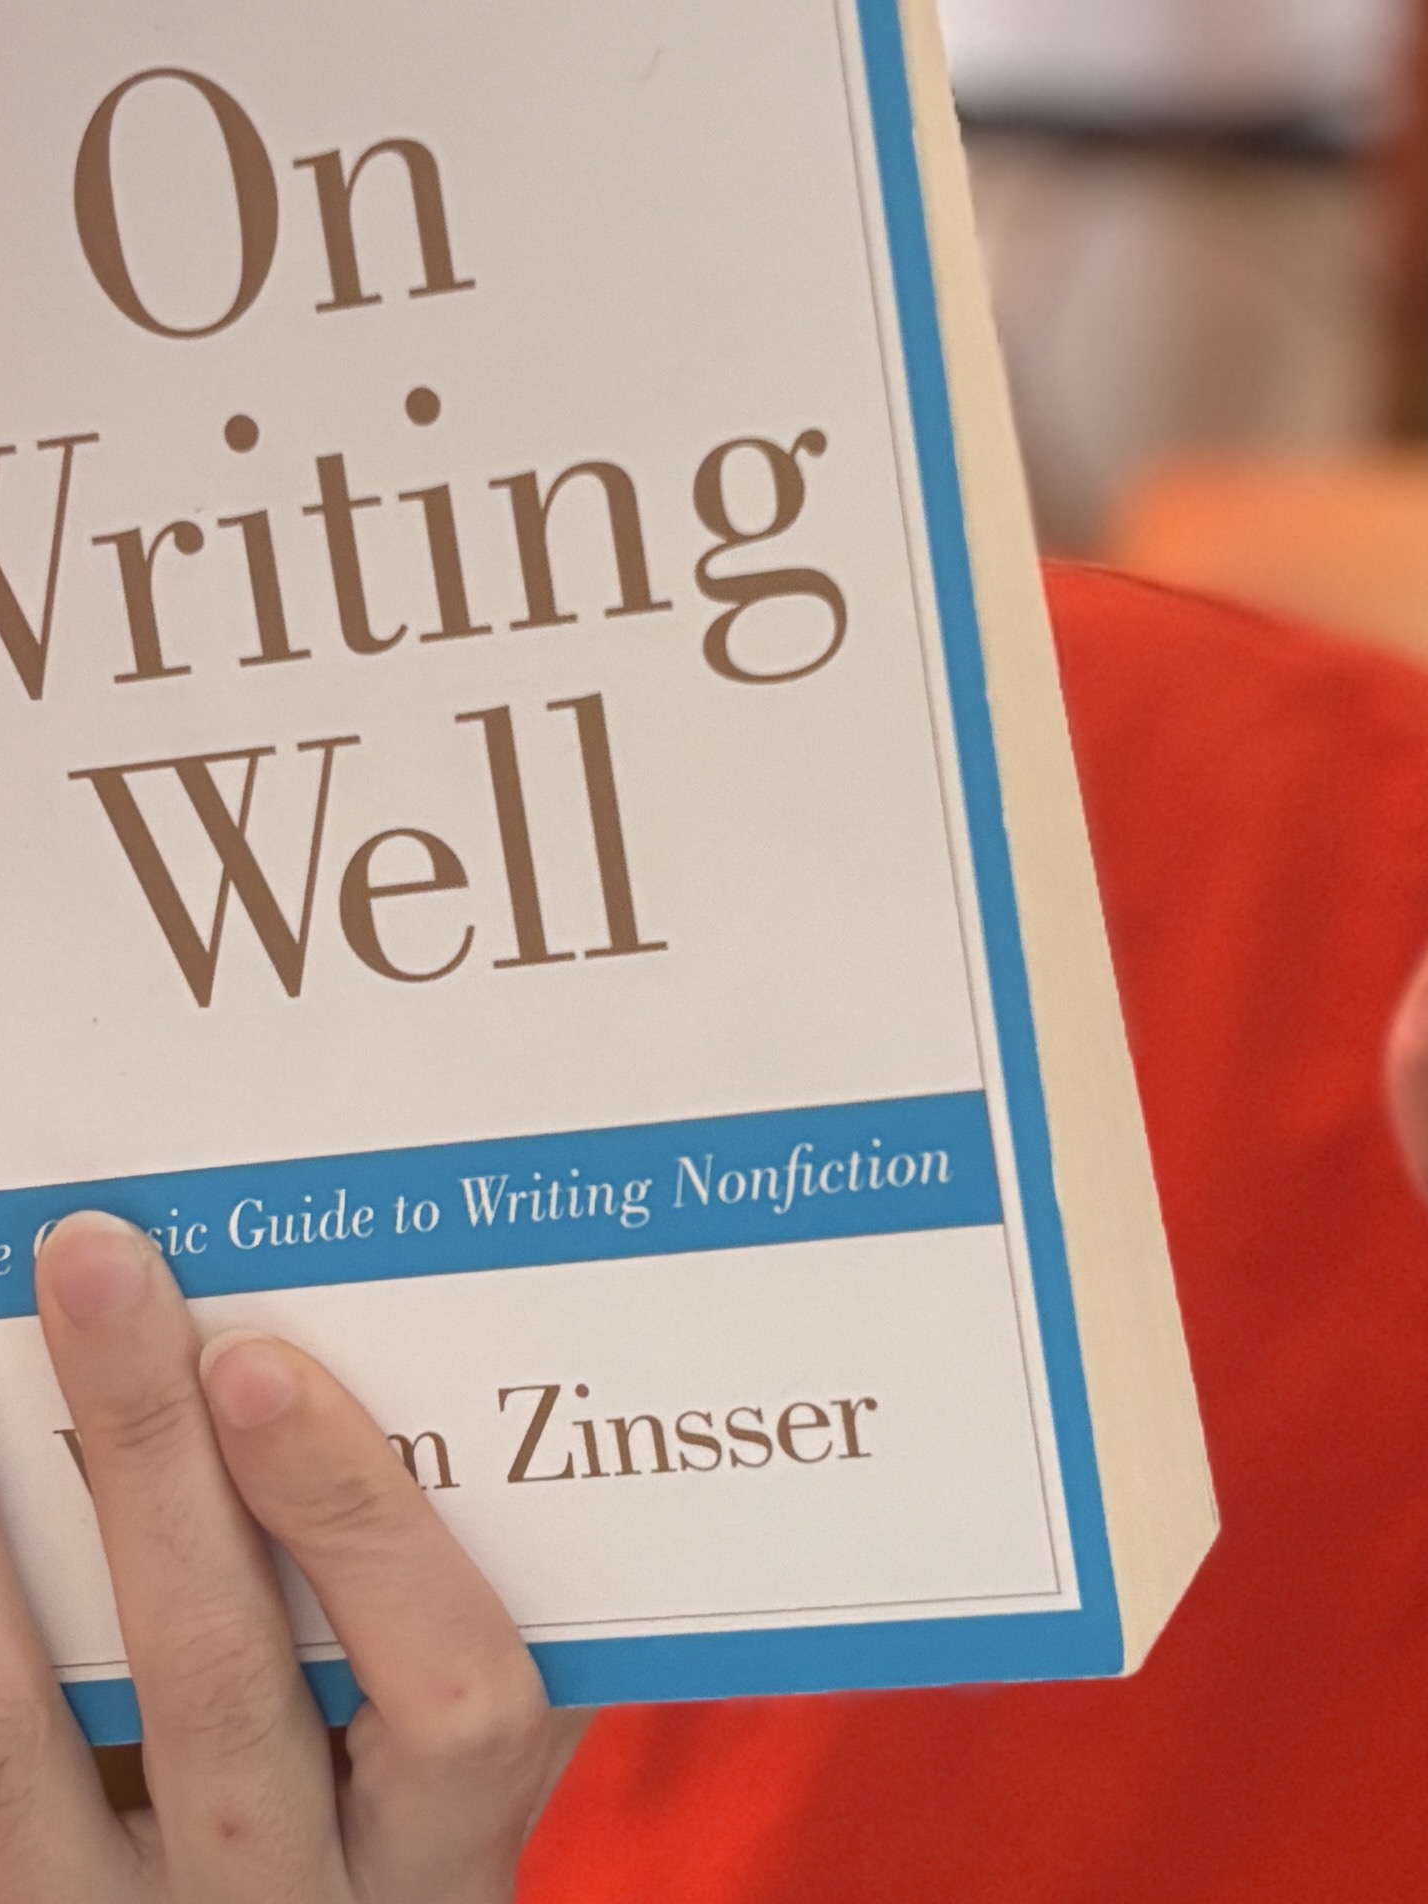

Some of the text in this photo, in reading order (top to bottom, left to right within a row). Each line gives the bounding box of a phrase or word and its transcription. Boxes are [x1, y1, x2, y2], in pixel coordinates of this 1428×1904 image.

[73, 67, 475, 339] On
[67, 693, 668, 1007] Well
[228, 1189, 373, 1253] Guide
[393, 1195, 440, 1235] to
[461, 1164, 652, 1228] Writing
[674, 1139, 953, 1214] Nonfiction
[498, 1382, 878, 1487] Zinsser
